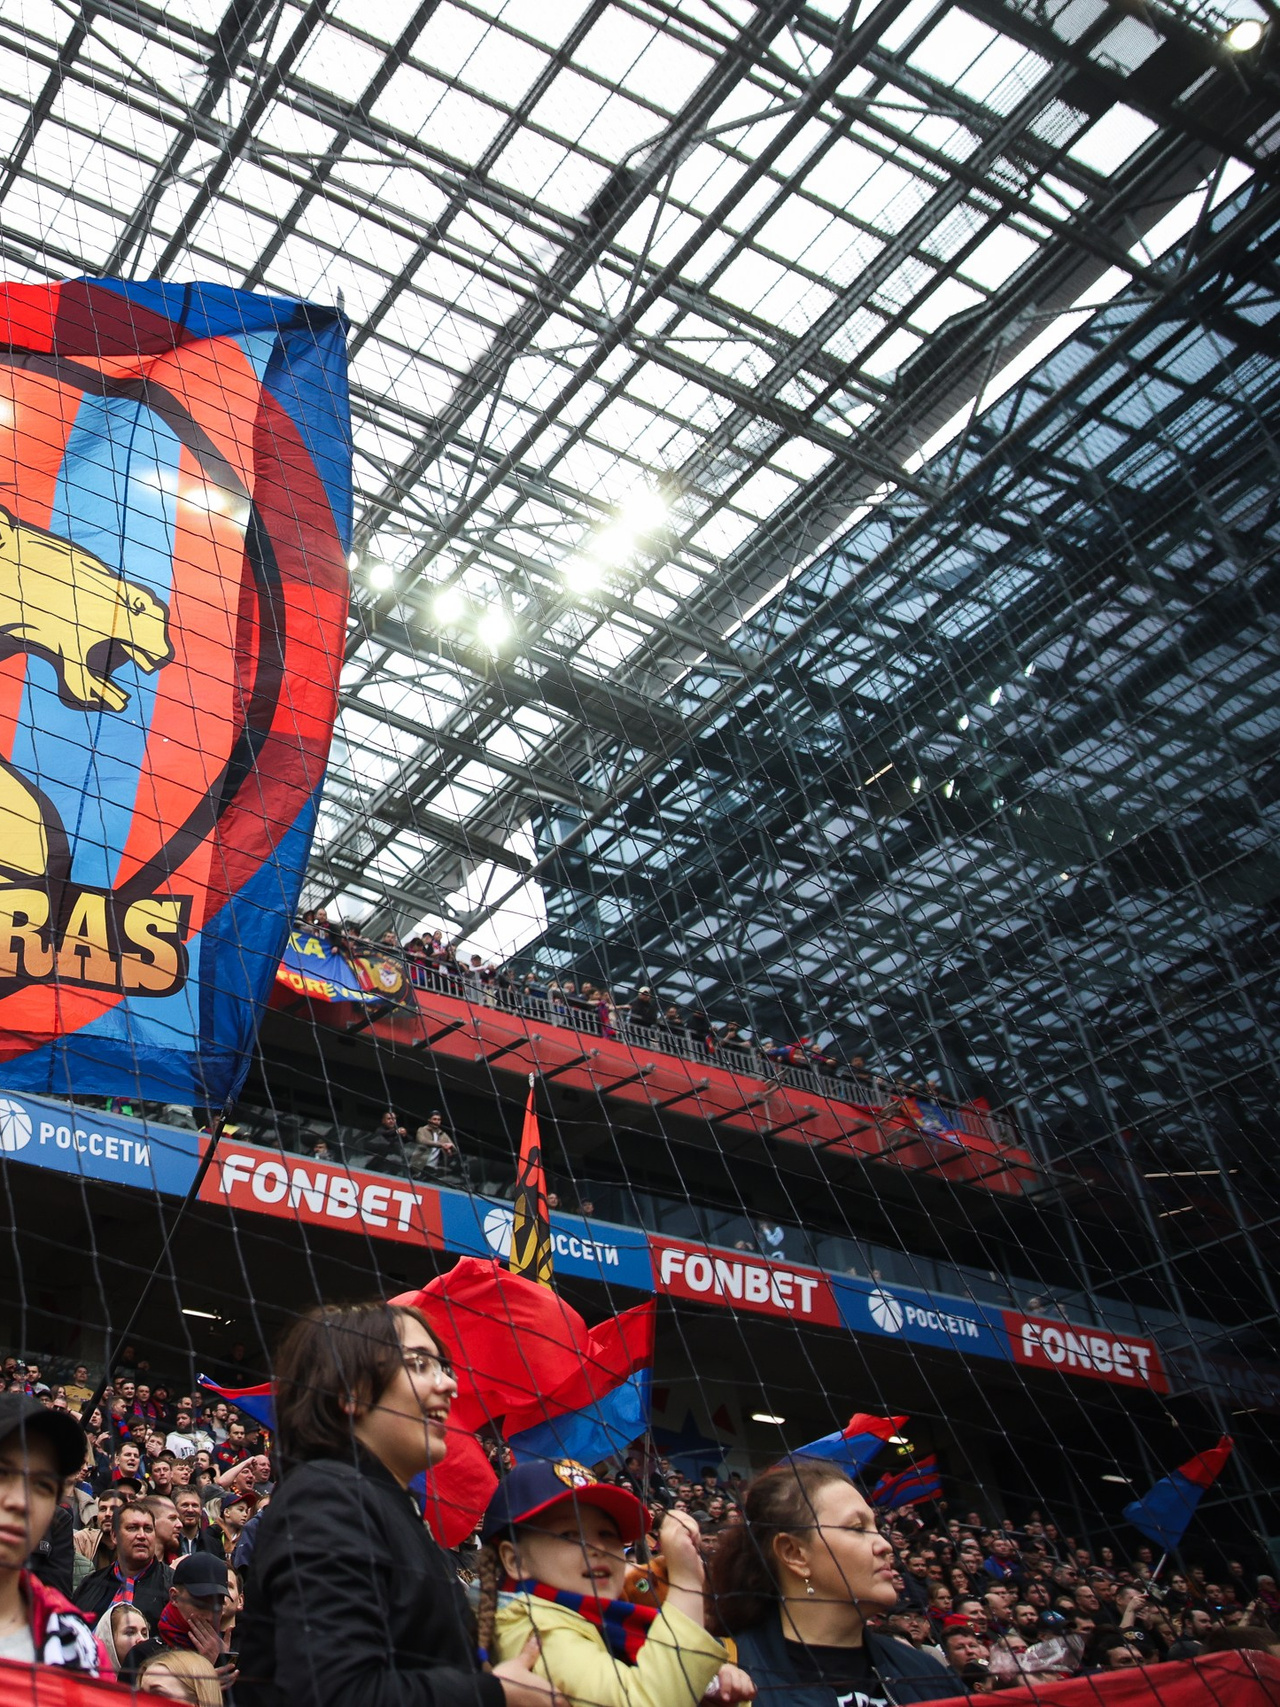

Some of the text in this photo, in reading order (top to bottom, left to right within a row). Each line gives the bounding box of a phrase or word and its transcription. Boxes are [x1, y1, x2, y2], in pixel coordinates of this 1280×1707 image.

[39, 1121, 152, 1168] РОССЕТИ
[219, 1153, 423, 1233] FONBET
[549, 1232, 620, 1267] ССЕТИ
[660, 1247, 819, 1313] FONBET
[905, 1306, 980, 1338] РОССЕТИ
[1021, 1322, 1151, 1381] FONBET
